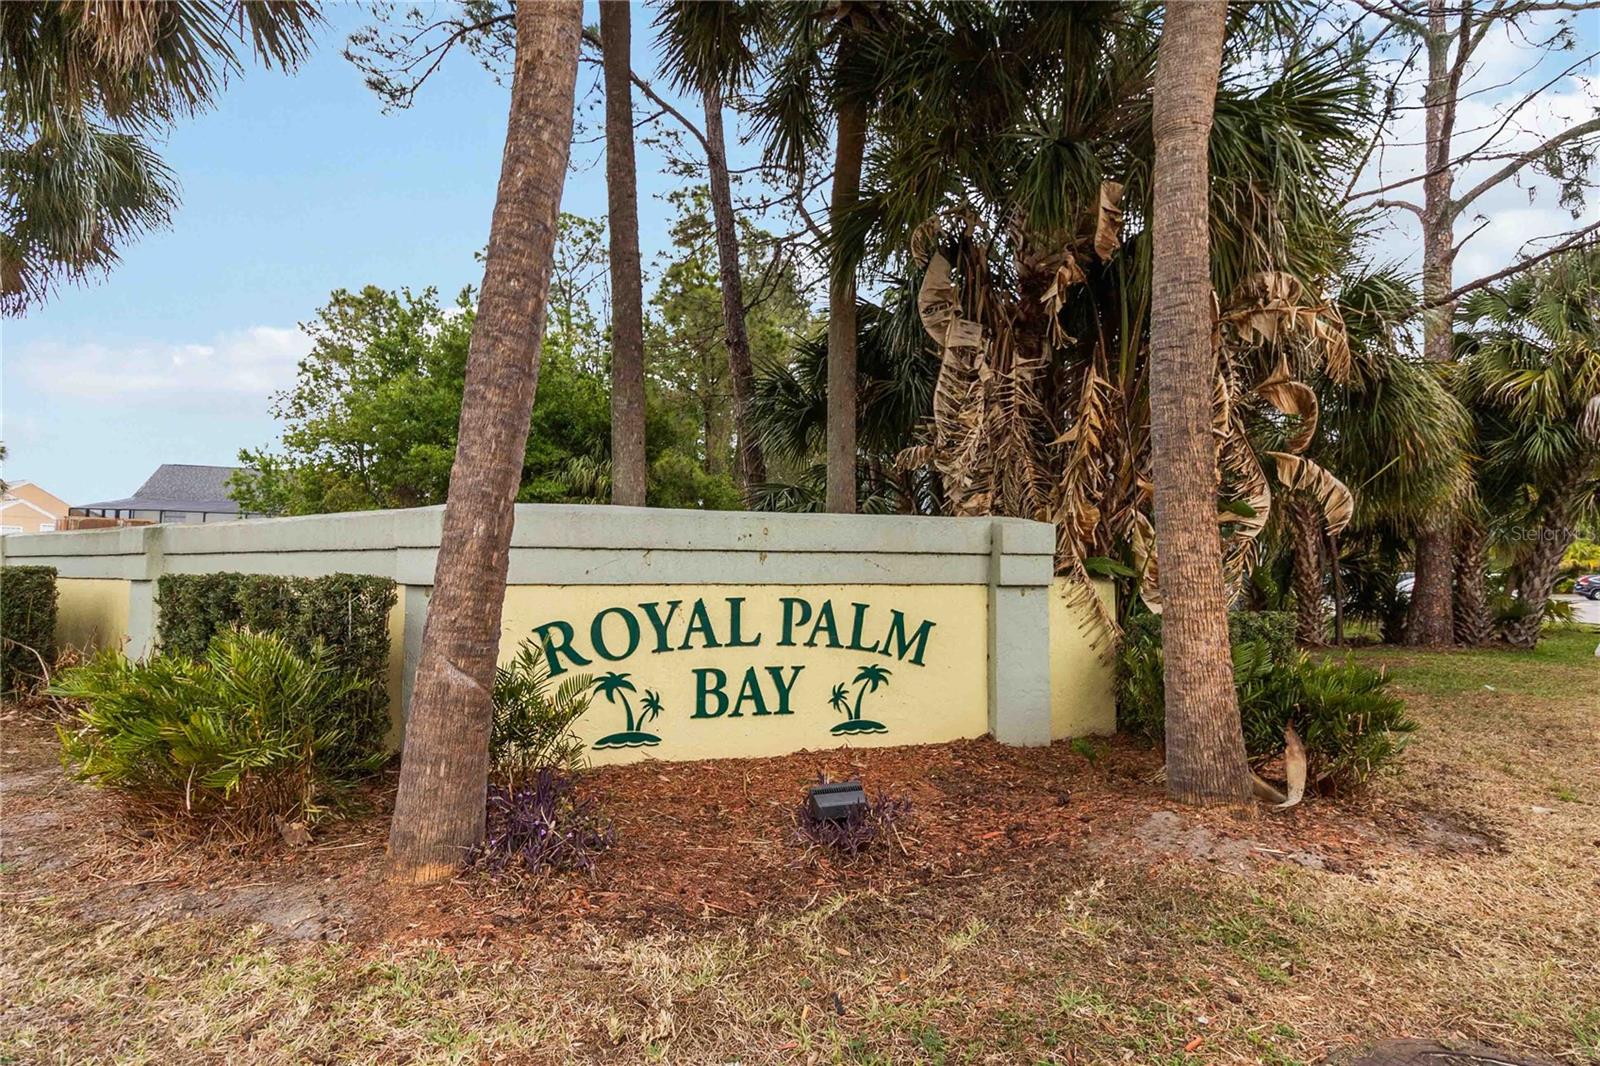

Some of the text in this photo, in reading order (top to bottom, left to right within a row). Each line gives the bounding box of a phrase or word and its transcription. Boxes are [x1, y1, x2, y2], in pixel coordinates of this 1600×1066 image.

[531, 597, 937, 679] ROYAL PALM
[690, 665, 805, 720] BAY
